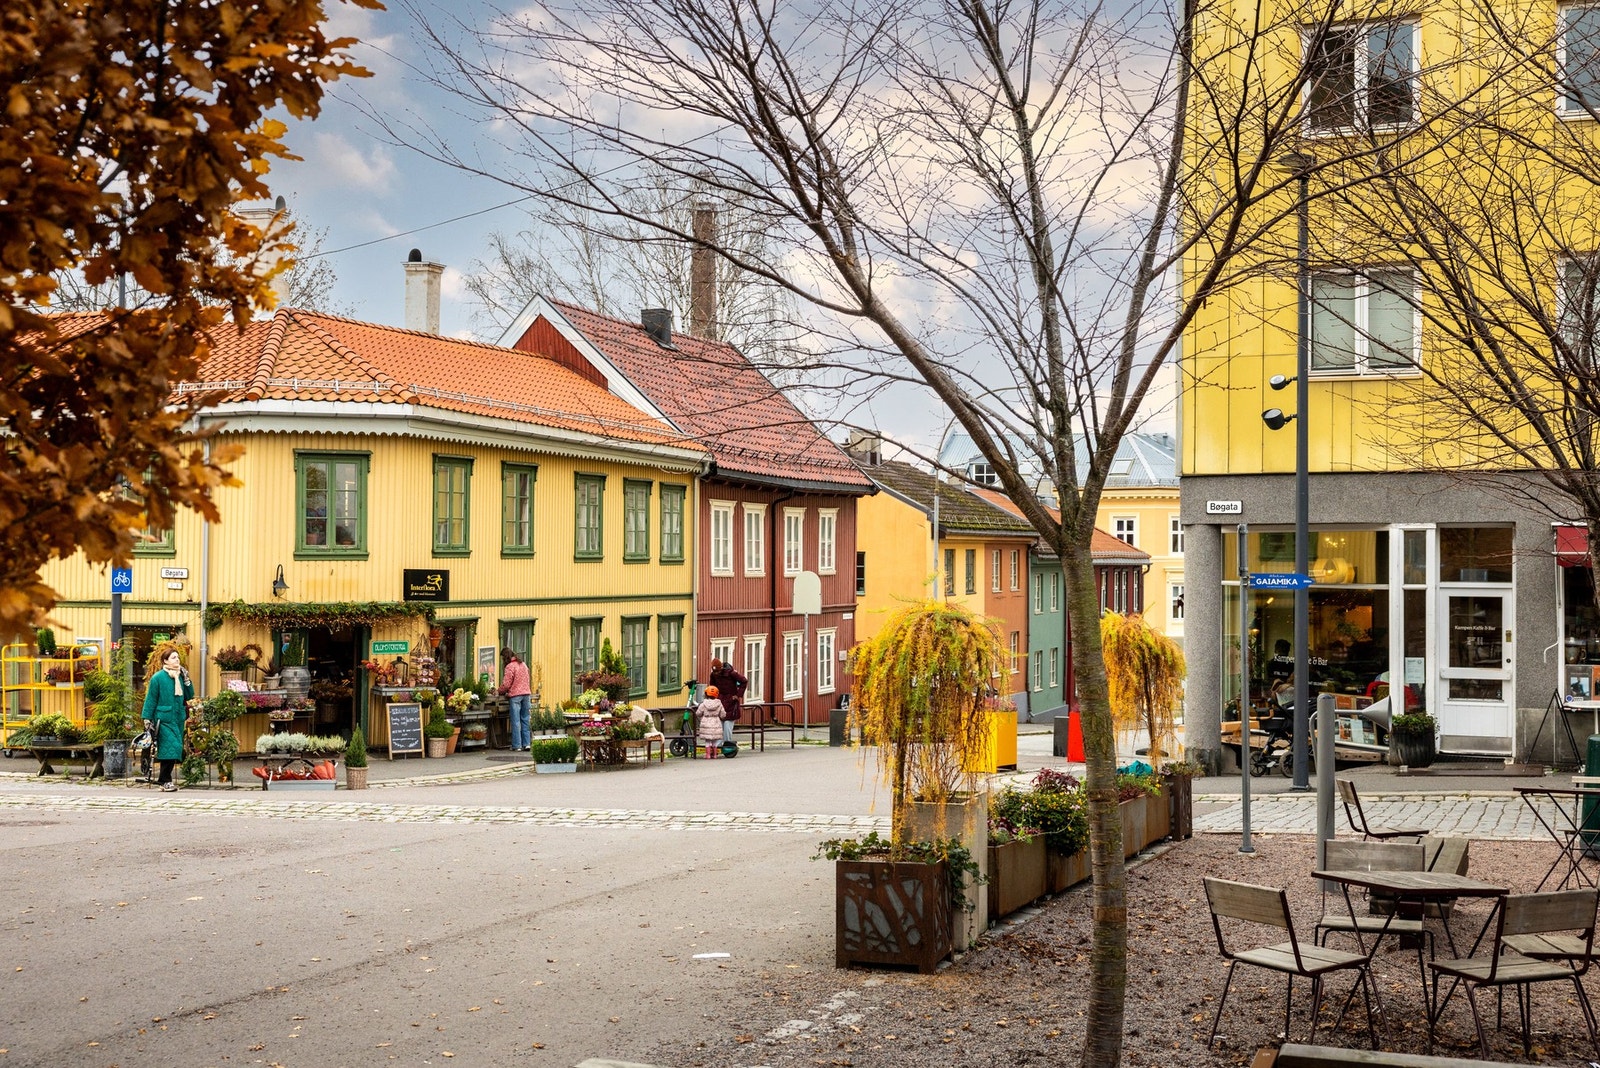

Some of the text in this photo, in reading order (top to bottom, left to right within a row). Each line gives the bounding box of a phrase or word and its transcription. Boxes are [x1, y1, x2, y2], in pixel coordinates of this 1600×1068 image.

[1210, 502, 1238, 512] Bøgata
[410, 583, 436, 591] Interflora
[1273, 653, 1295, 664] Kampe
[1317, 657, 1328, 666] Bar
